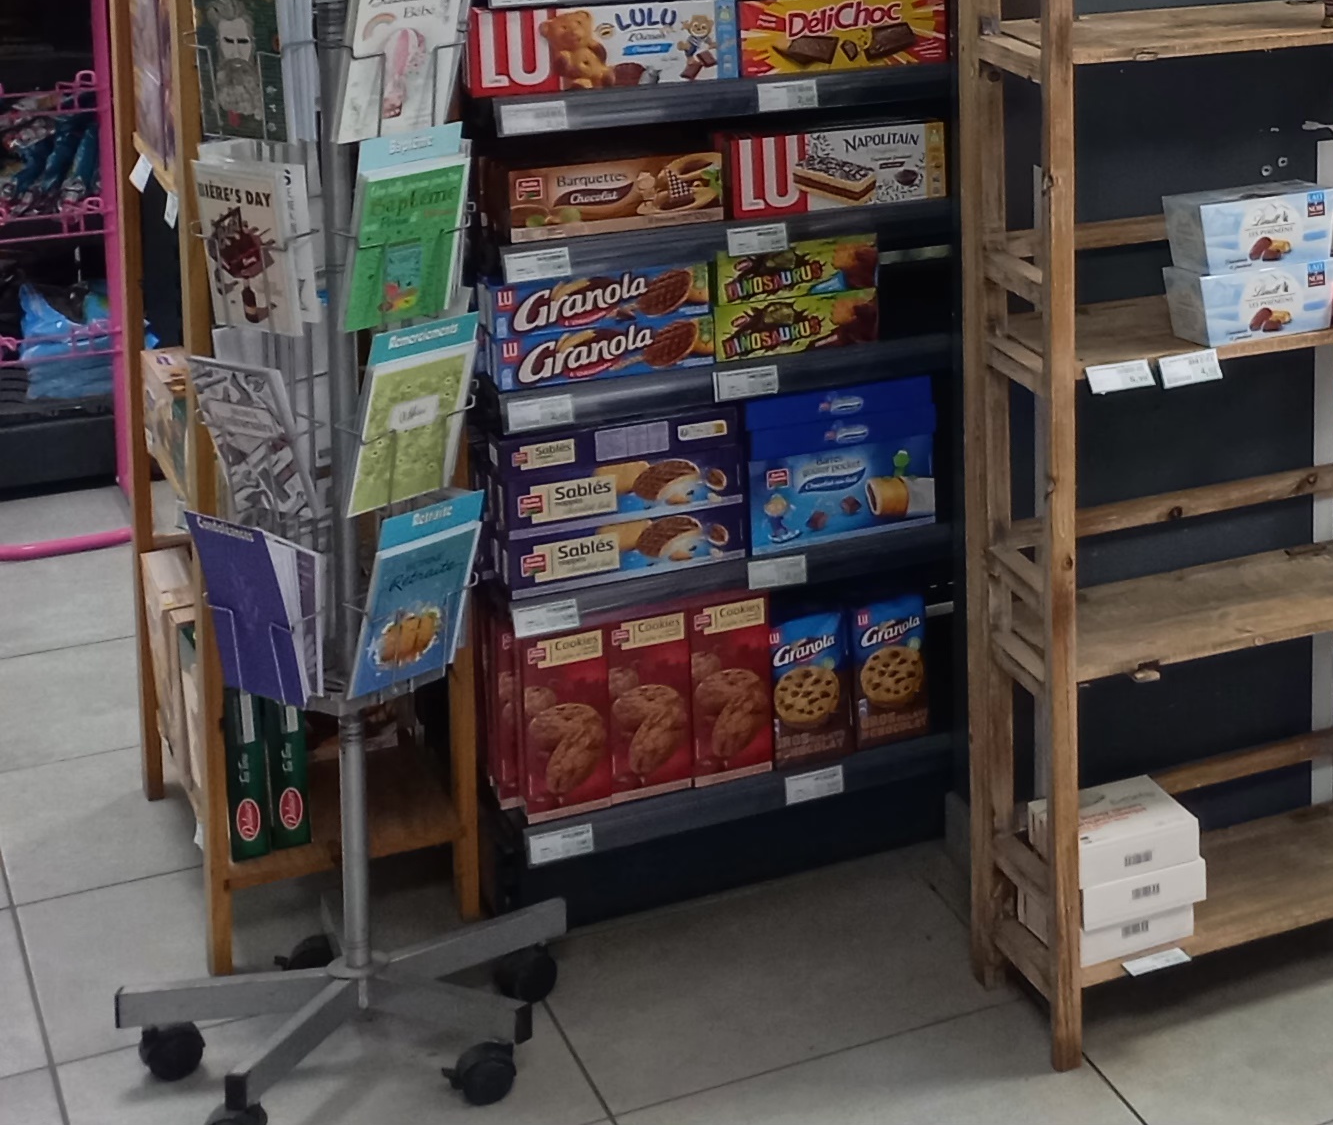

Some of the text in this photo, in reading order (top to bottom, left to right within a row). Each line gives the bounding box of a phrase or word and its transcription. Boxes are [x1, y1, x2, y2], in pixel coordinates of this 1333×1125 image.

[614, 7, 678, 32] LULU
[787, 0, 902, 40] DéliChoc
[487, 7, 552, 89] LU
[843, 132, 920, 152] NAPOLITAIN
[556, 171, 628, 190] Barquettes
[738, 133, 799, 213] LU
[245, 190, 271, 208] DAY
[569, 189, 619, 206] Chocolat
[726, 261, 824, 302] DINOSAURUS
[497, 291, 513, 308] LU
[513, 271, 649, 333] Granola
[724, 316, 824, 357] DINOSAURUS
[503, 342, 518, 358] LU
[517, 324, 655, 384] Granola
[554, 479, 613, 502] Sablés
[557, 538, 615, 561] Sablés
[718, 602, 761, 620] Cookies
[858, 613, 869, 626] LU
[637, 616, 680, 634] Cookies
[861, 614, 921, 648] Granola
[555, 634, 600, 653] Cookies
[769, 632, 780, 644] LU
[773, 633, 836, 667] Granola
